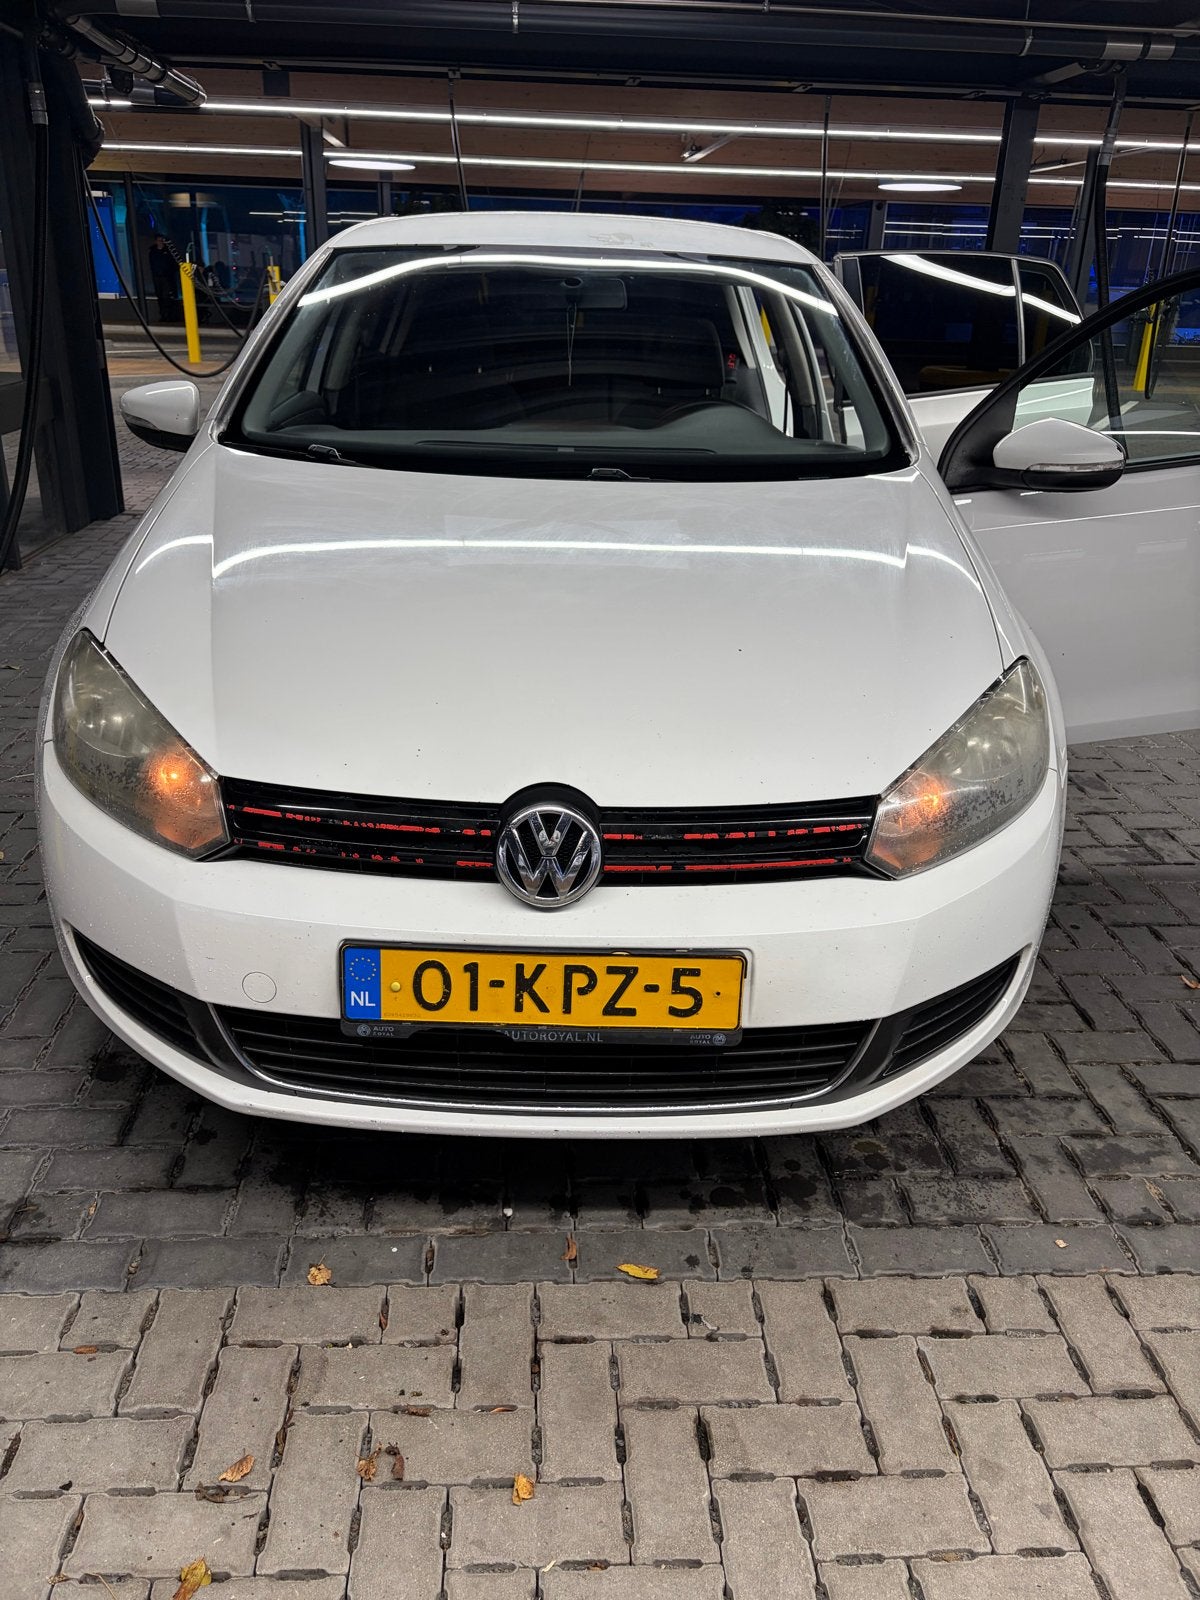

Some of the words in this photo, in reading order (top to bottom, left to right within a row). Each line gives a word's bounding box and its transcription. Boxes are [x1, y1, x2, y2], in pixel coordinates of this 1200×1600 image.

[412, 959, 703, 1017] 01-KPZ-5
[350, 990, 376, 1007] NL
[496, 1030, 603, 1042] AUTOROYAL.NL
